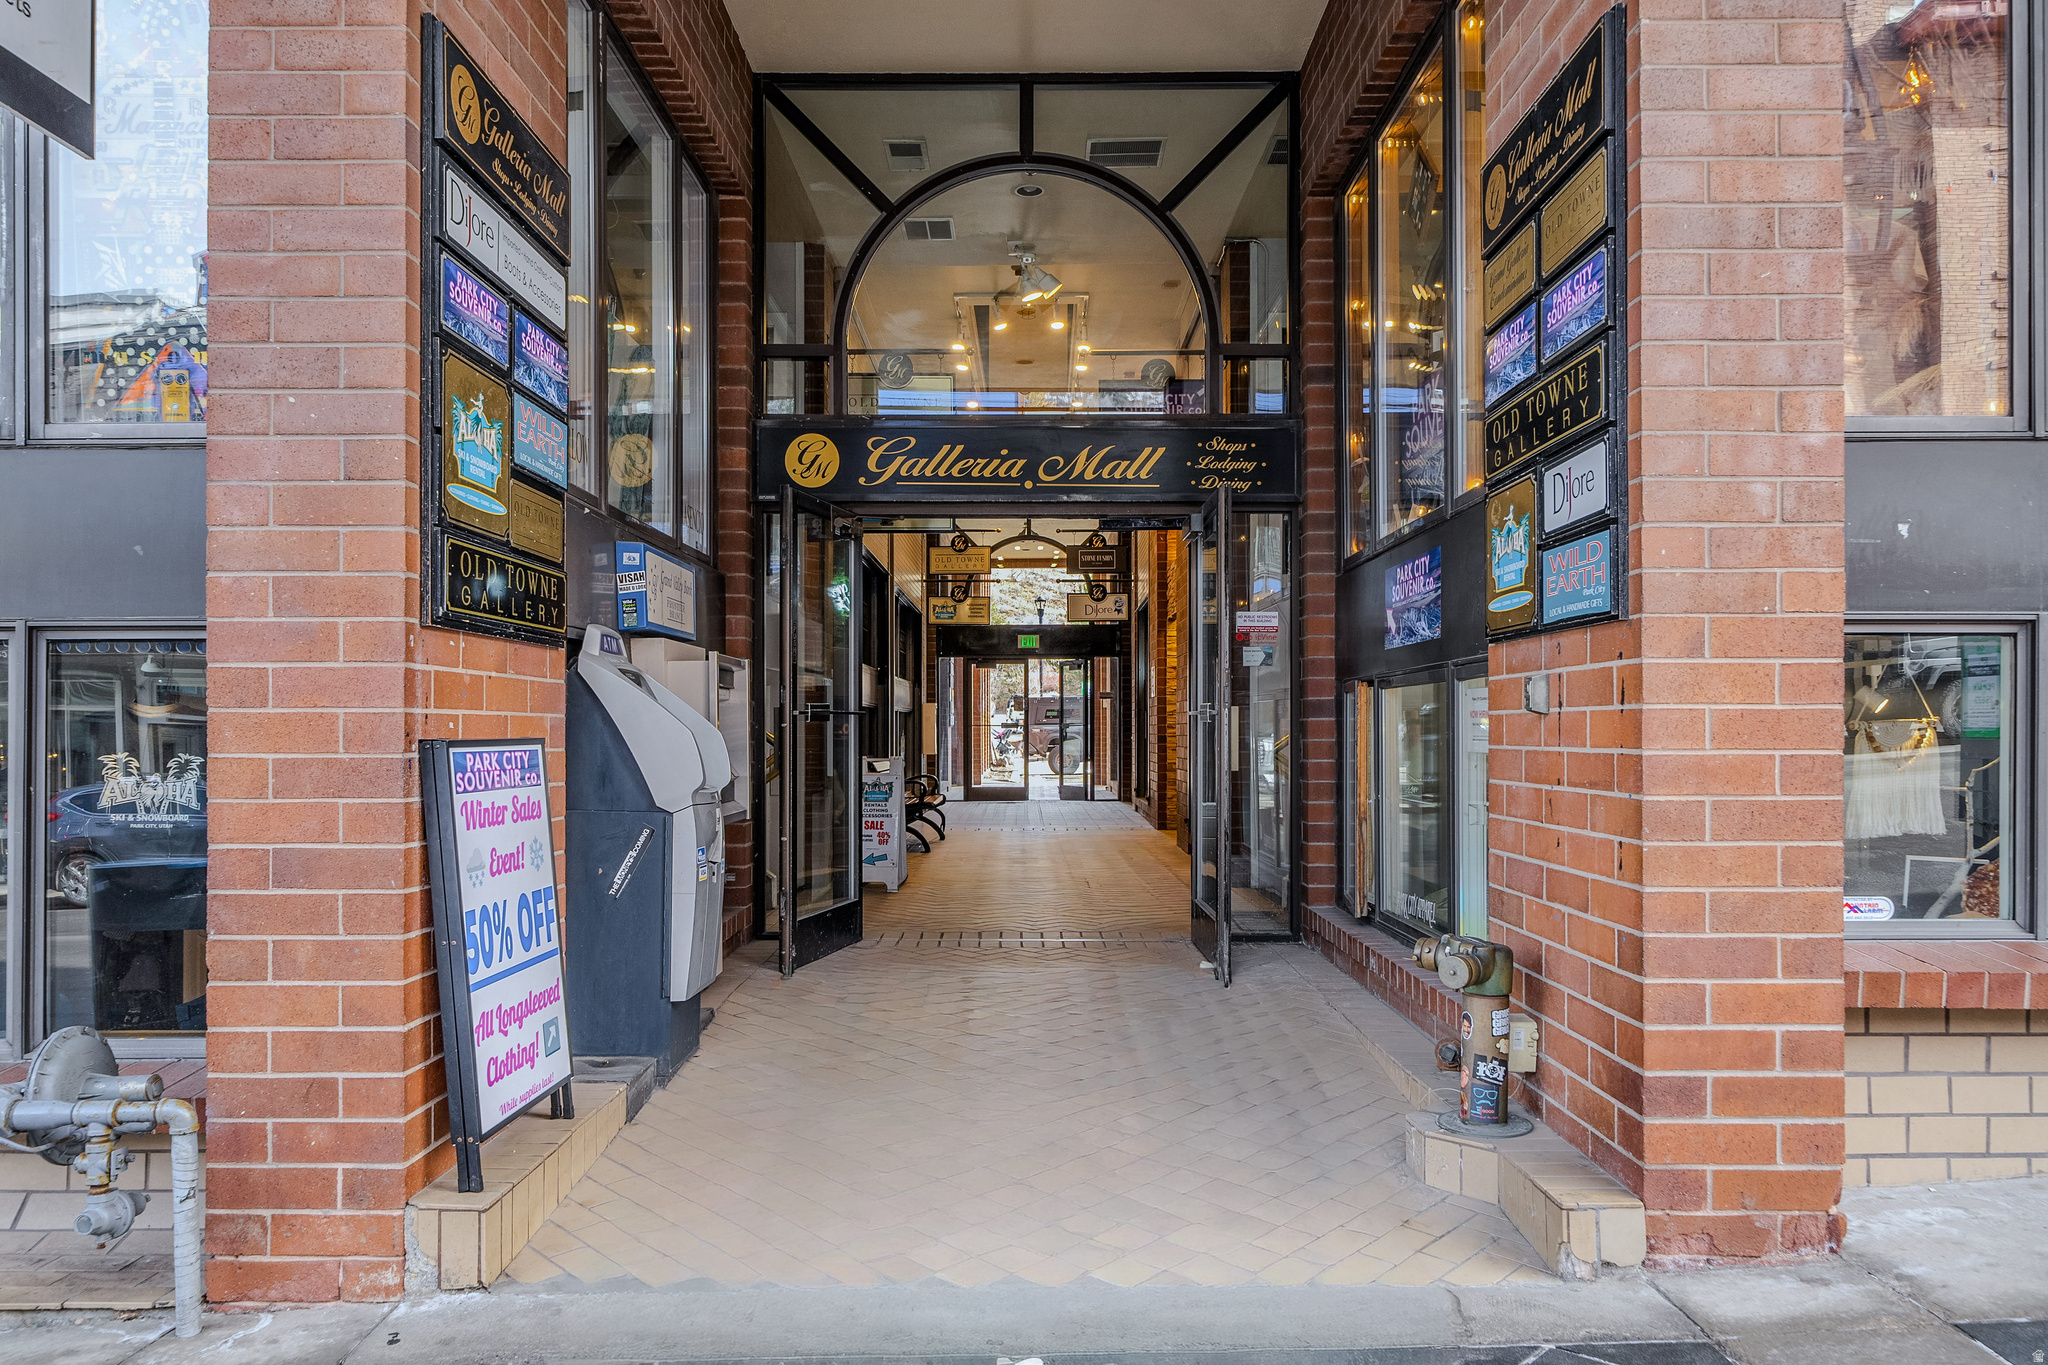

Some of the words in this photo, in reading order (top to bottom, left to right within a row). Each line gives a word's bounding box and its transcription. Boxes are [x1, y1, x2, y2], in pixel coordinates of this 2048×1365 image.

[1507, 120, 1553, 198] Galleria
[1554, 56, 1597, 138] Mall
[482, 98, 531, 182] Galleria
[533, 174, 566, 217] Mall
[1535, 152, 1560, 185] Lodging
[1561, 122, 1586, 155] Dining
[492, 158, 510, 187] Shops
[513, 179, 537, 216] Lodging
[540, 208, 559, 238] Dining
[1545, 216, 1563, 239] OLD
[1566, 174, 1601, 215] TOWNE
[457, 270, 478, 300] PARK
[480, 290, 499, 315] CITY
[504, 254, 521, 282] Boots
[522, 273, 527, 286] &
[528, 278, 561, 316] Accessories
[1552, 284, 1572, 306] PARK
[1573, 262, 1594, 292] CITY
[449, 281, 492, 325] SOUVENIR
[1547, 289, 1587, 329] SOUVENIR
[521, 333, 554, 367] SOUVENIR
[527, 323, 544, 348] PARK
[545, 338, 560, 359] CITY
[1493, 327, 1508, 352] PARK
[1509, 314, 1525, 339] CITY
[1489, 336, 1519, 369] SOUVENIR
[848, 397, 879, 408] OLD
[1165, 393, 1195, 405] CITY
[1493, 408, 1520, 444] OLD
[1526, 362, 1588, 422] TOWNE
[520, 402, 563, 442] WILD
[1494, 396, 1589, 467] GALLERY
[518, 421, 565, 464] EARTH
[1205, 436, 1248, 455] Shops
[470, 454, 498, 475] SNOWBOARD
[858, 435, 1028, 487] Galleria
[1038, 445, 1167, 482] Mall
[1194, 455, 1258, 473] Lodging
[514, 501, 531, 518] OLD
[534, 509, 560, 531] TOWNE
[1397, 562, 1413, 584] PARK
[1414, 555, 1430, 577] CITY
[1504, 560, 1525, 574] SNOWBOARD
[1549, 541, 1603, 574] WILD
[460, 551, 497, 584] OLD
[505, 564, 558, 601] TOWNE
[618, 572, 645, 584] VISAH
[1391, 576, 1424, 602] SOUVENIR
[1546, 562, 1606, 597] EARTH
[1582, 586, 1594, 596] Park
[1593, 585, 1606, 595] City
[461, 585, 558, 625] GALLERY
[1549, 606, 1562, 617] LOCAL
[1566, 600, 1591, 612] HANDMADE
[1591, 598, 1603, 609] GIFTS
[603, 635, 619, 654] ATM
[1021, 635, 1037, 648] EXIT
[465, 753, 501, 772] PARK
[503, 751, 530, 770] CITY
[456, 769, 523, 794] SOUVENIR
[110, 813, 126, 822] SKI
[127, 813, 134, 822] &
[136, 814, 189, 822] SNOWBOARD
[460, 799, 508, 831] Winter
[512, 794, 542, 824] Sales
[864, 820, 885, 831] SALE
[877, 831, 891, 839] 40%
[878, 838, 889, 846] OFF
[489, 841, 525, 878] Event!
[609, 881, 620, 895] THE
[633, 828, 650, 854] COMING
[465, 899, 514, 975] 50%
[518, 886, 556, 953] OFF
[475, 1010, 494, 1048] All
[496, 977, 561, 1037] Longsleeved
[487, 1031, 540, 1088] Clothing!
[499, 1099, 518, 1117] While
[518, 1084, 542, 1108] supplies
